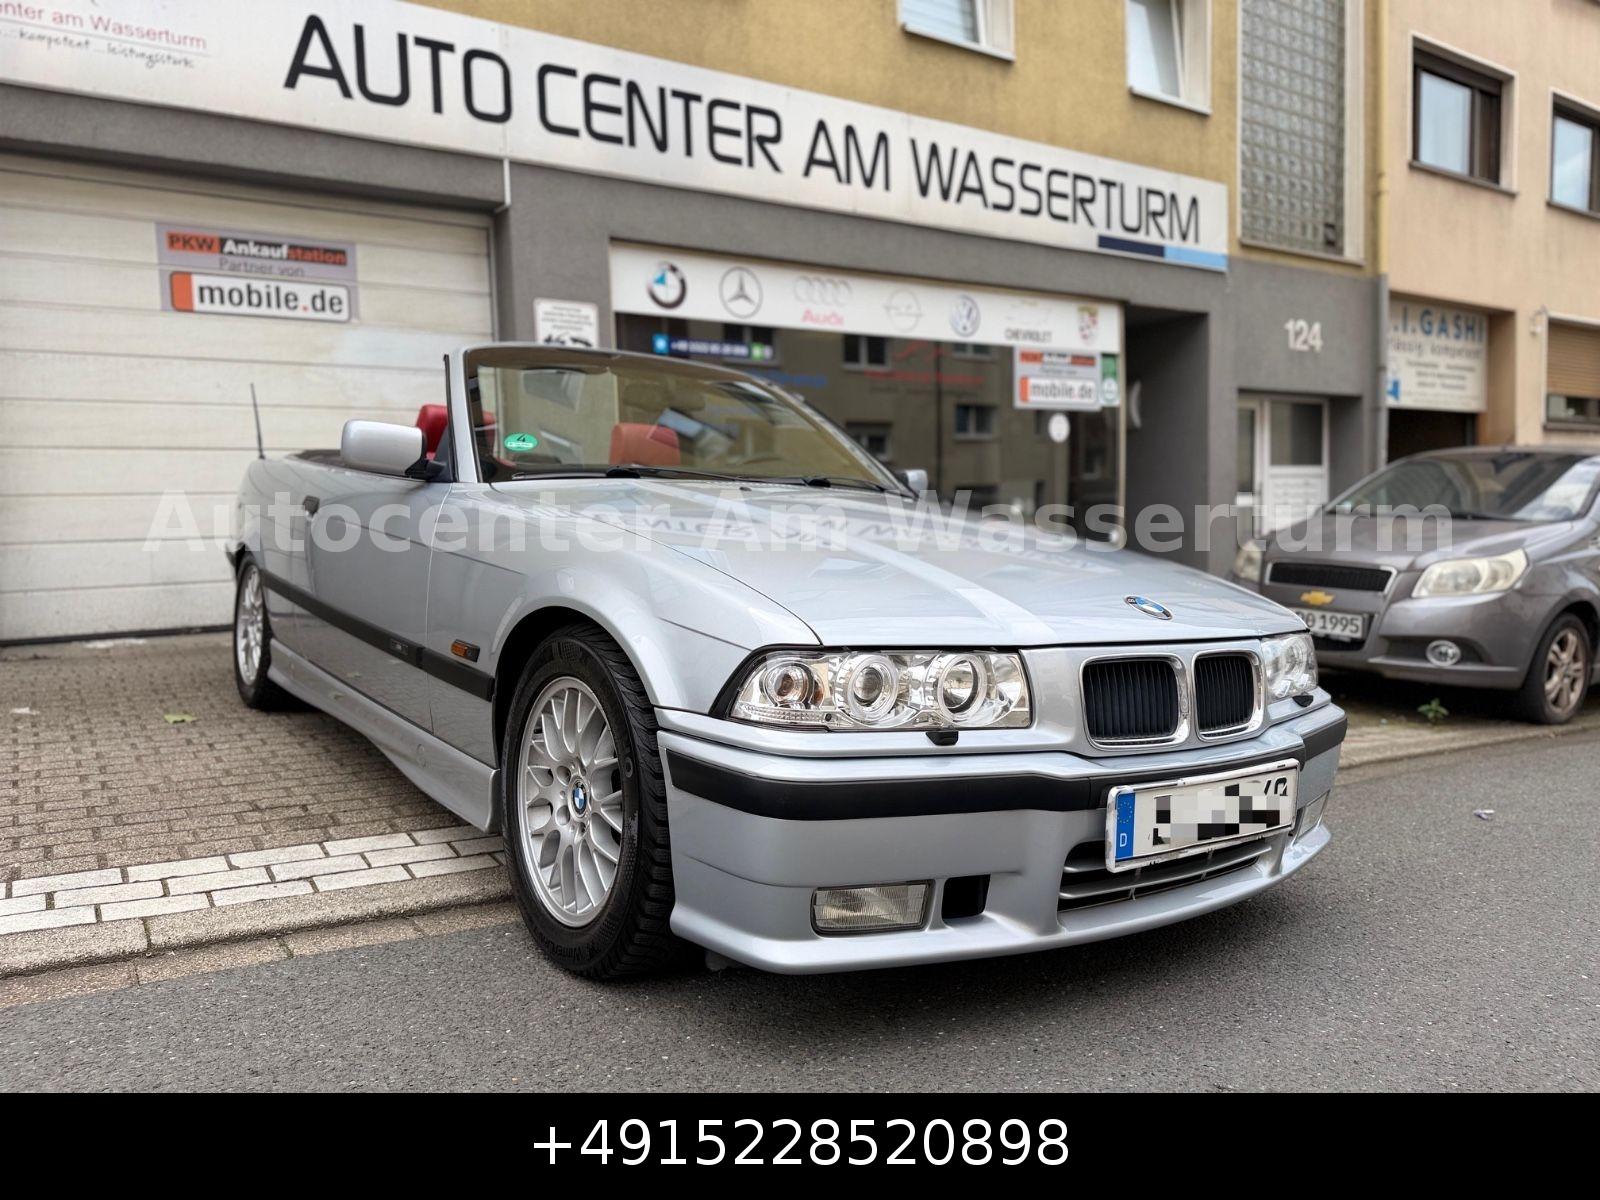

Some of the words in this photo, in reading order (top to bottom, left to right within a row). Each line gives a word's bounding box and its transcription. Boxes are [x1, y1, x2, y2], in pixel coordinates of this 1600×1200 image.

[0, 2, 44, 20] nter
[52, 11, 84, 27] am
[91, 15, 206, 48] Wasserturm
[284, 14, 512, 124] AUTO
[537, 63, 783, 173] CENTER
[803, 119, 890, 192] AM
[909, 138, 1200, 243] WASSERTURM
[168, 232, 215, 251] PKW
[222, 238, 347, 266] Ankaufstation
[219, 257, 274, 275] Partner
[278, 265, 305, 278] von
[198, 283, 344, 314] mobile.de
[1284, 318, 1324, 353] 124
[1031, 380, 1093, 400] mobile.de
[1318, 613, 1360, 634] 1995
[1119, 832, 1128, 848] D
